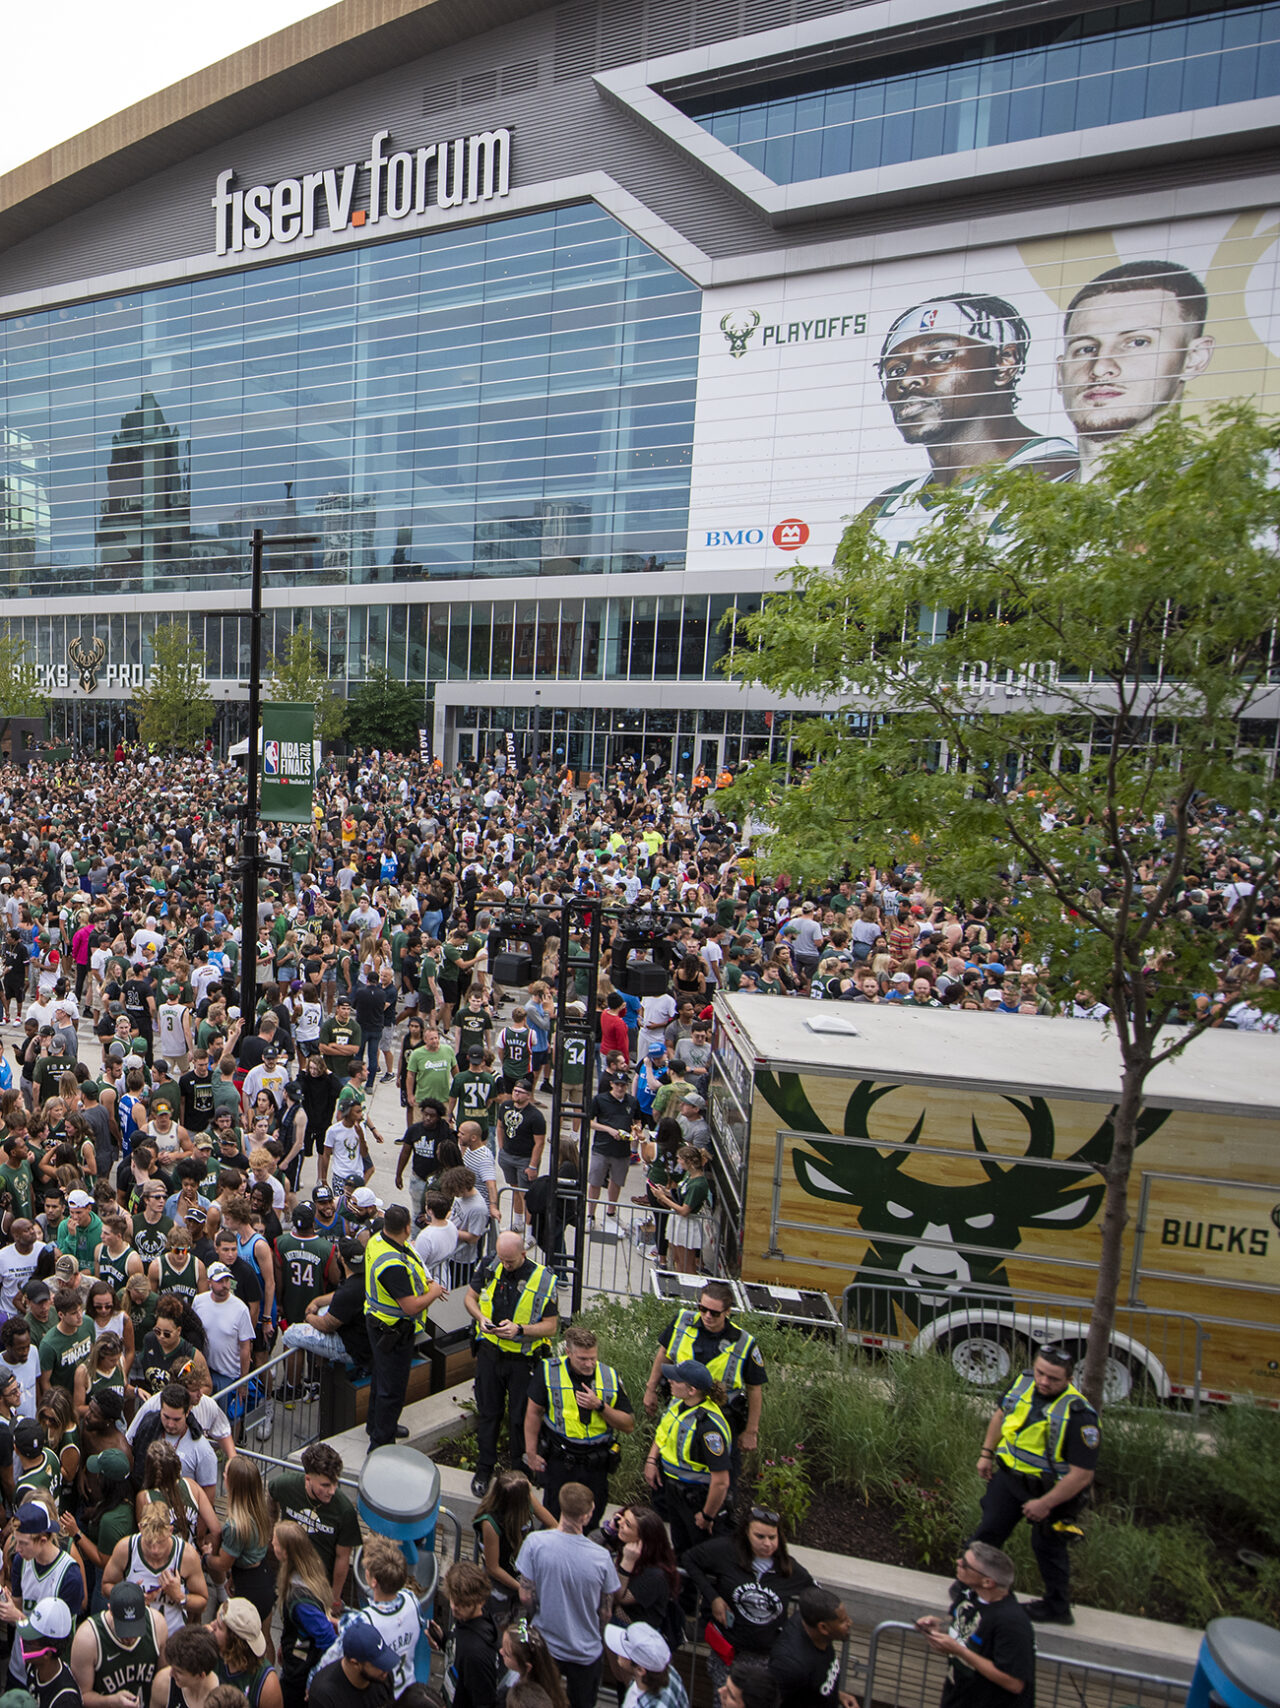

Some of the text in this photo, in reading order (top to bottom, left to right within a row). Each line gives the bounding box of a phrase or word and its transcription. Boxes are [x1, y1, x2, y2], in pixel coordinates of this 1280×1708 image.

[212, 130, 512, 256] fiserv.forum
[762, 314, 867, 347] PLAYOFFS
[705, 529, 764, 547] BMO
[106, 663, 145, 688] PRO
[419, 729, 428, 749] BAG
[505, 732, 516, 753] BAG
[280, 742, 311, 761] NBA 2021
[280, 760, 312, 776] FINALS
[166, 1016, 174, 1032] 3
[306, 1015, 318, 1026] 34
[506, 1039, 527, 1049] PARKER
[509, 1047, 523, 1061] 12
[567, 1047, 585, 1065] 34
[1161, 1218, 1270, 1257] BUCKS
[290, 1265, 315, 1288] 34
[61, 1340, 91, 1368] FINALS
[743, 1582, 756, 1591] NO
[103, 1663, 156, 1693] BUCKS
